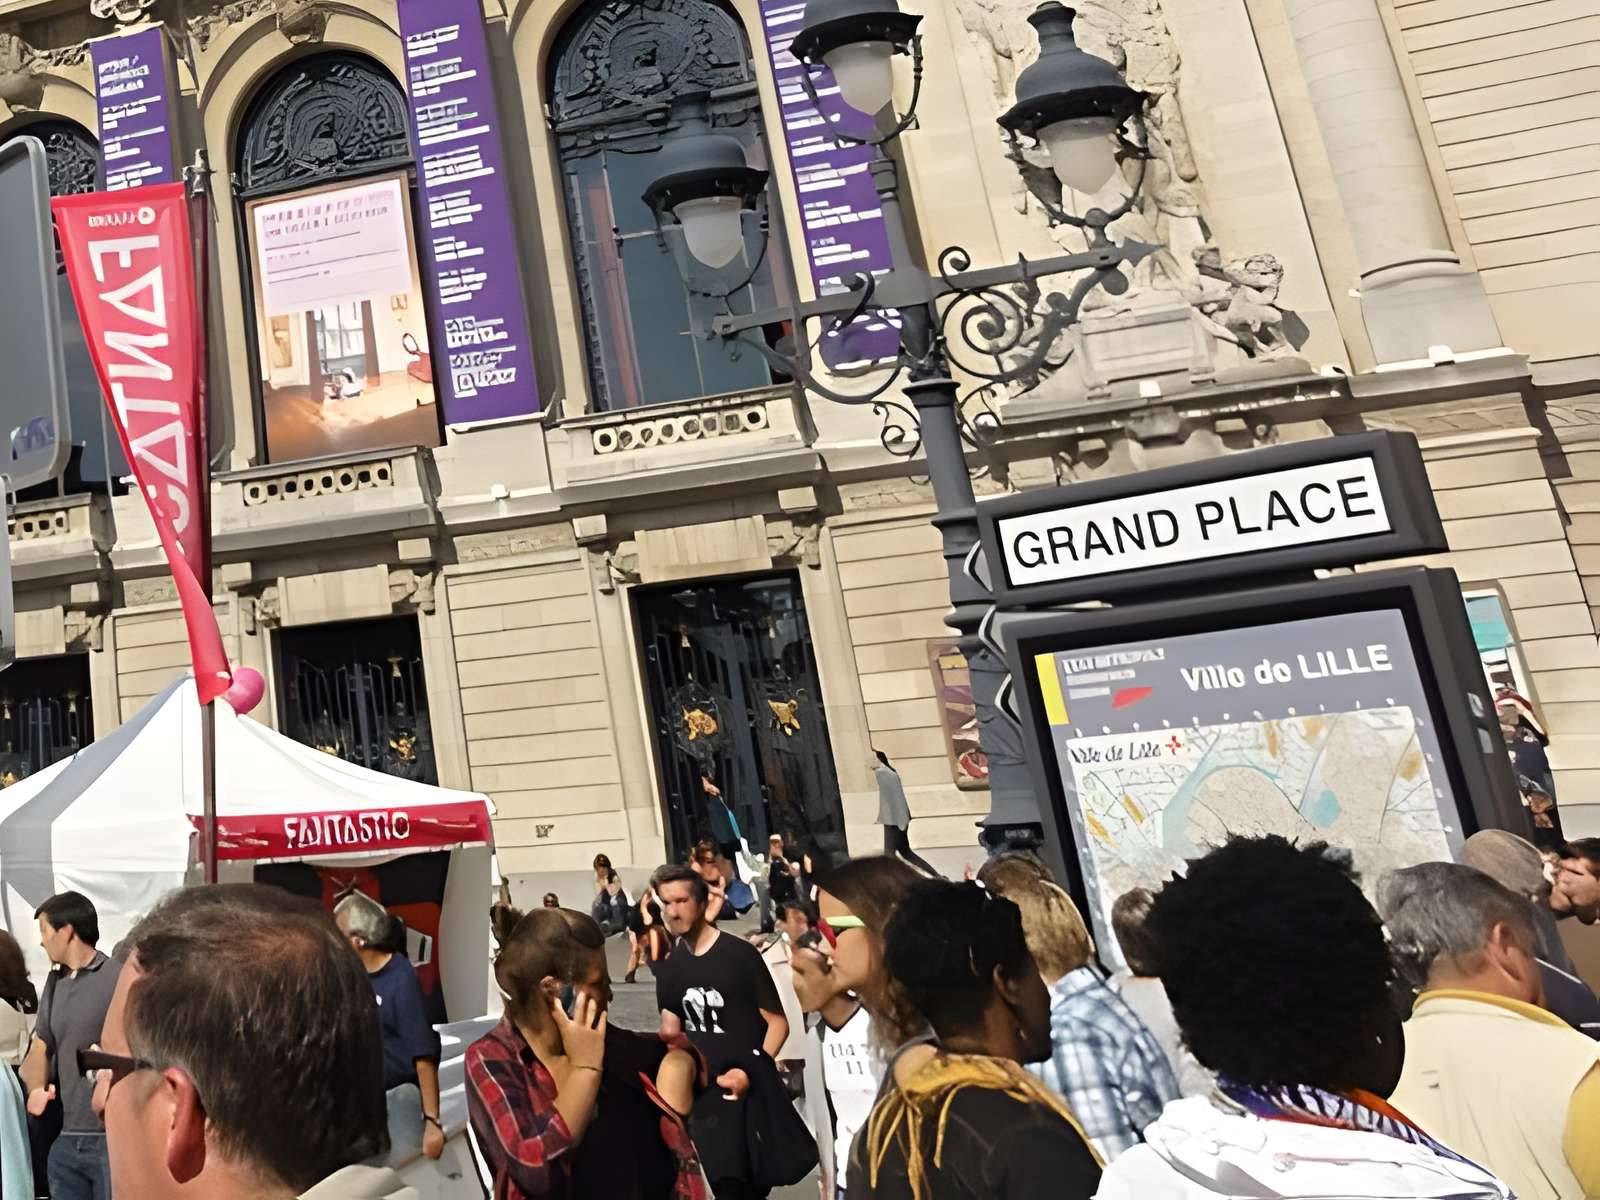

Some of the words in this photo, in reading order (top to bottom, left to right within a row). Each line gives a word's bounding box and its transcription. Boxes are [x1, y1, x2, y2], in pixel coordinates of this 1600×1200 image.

[1013, 509, 1180, 568] GRAND
[1195, 475, 1376, 540] PLACE
[1297, 644, 1393, 679] LILLE
